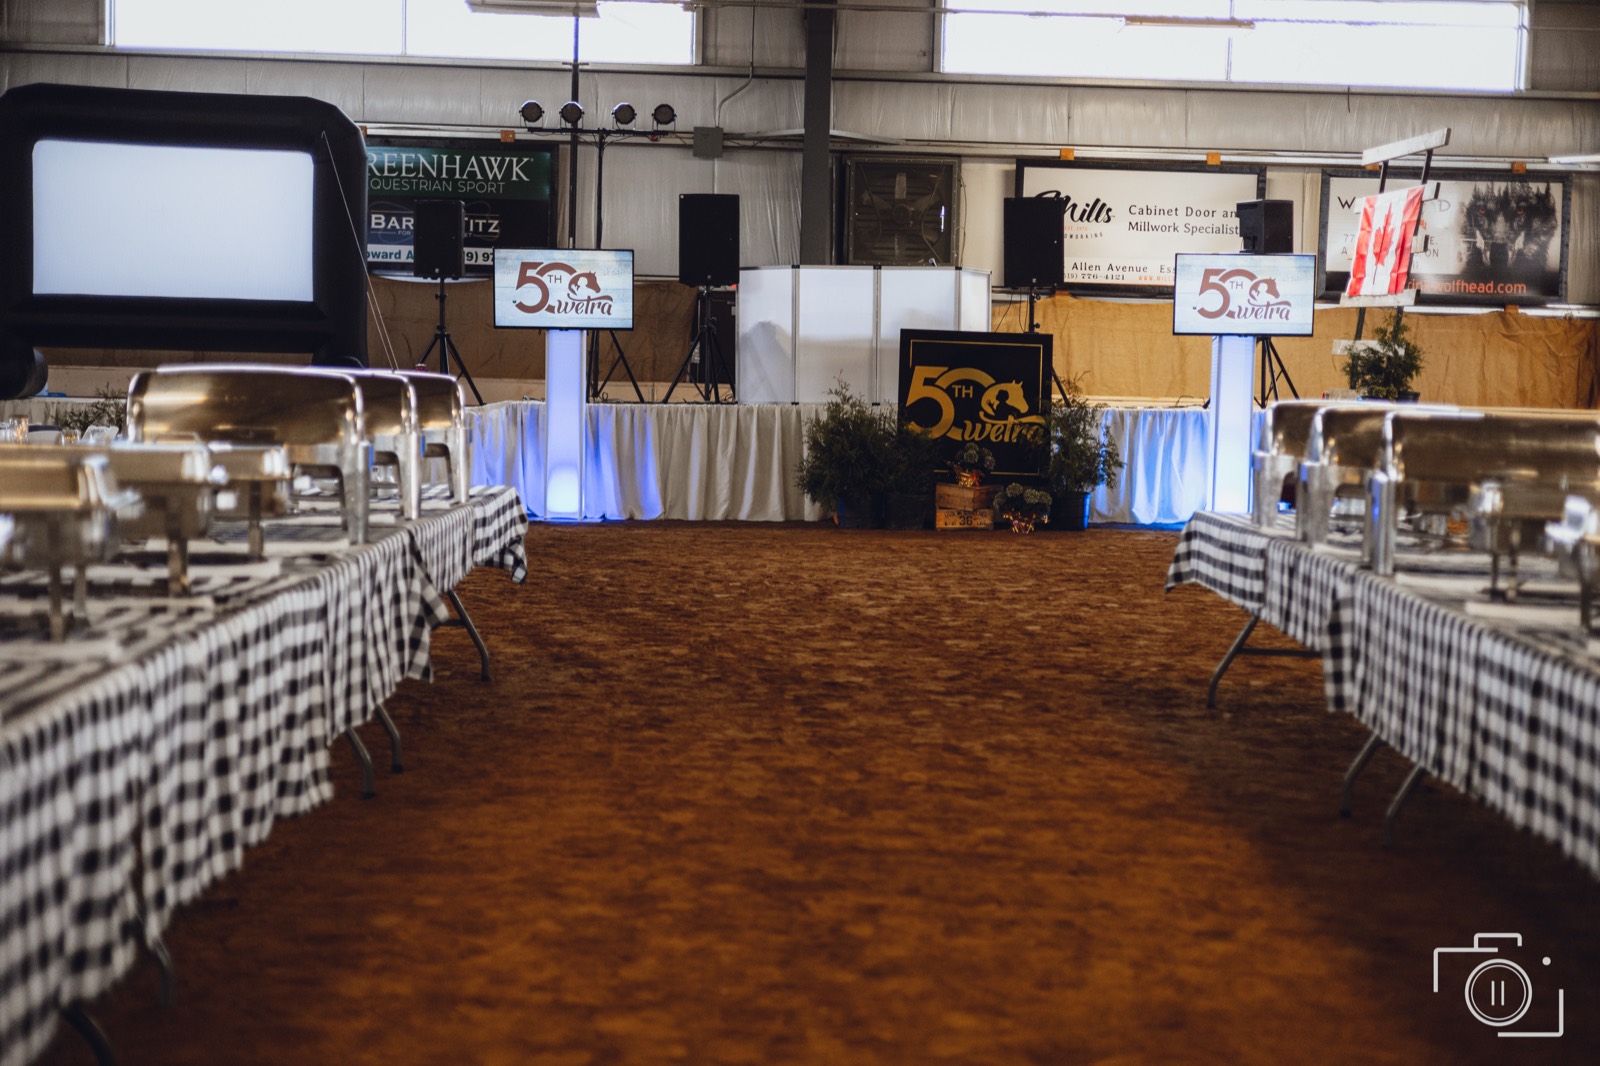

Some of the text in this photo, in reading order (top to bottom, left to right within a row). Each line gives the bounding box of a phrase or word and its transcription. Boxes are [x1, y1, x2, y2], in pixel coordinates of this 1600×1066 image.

[368, 177, 505, 194] QUESTRIAN SPORT
[1128, 204, 1179, 217] Cabinet
[1185, 206, 1217, 218] Door
[1128, 217, 1180, 232] Millwork
[1071, 261, 1101, 272] Allen
[1107, 263, 1148, 273] Avenue
[547, 275, 562, 284] TH
[1229, 281, 1244, 290] TH
[556, 295, 614, 316] wetra
[1237, 301, 1291, 321] wetra
[951, 384, 974, 399] TH
